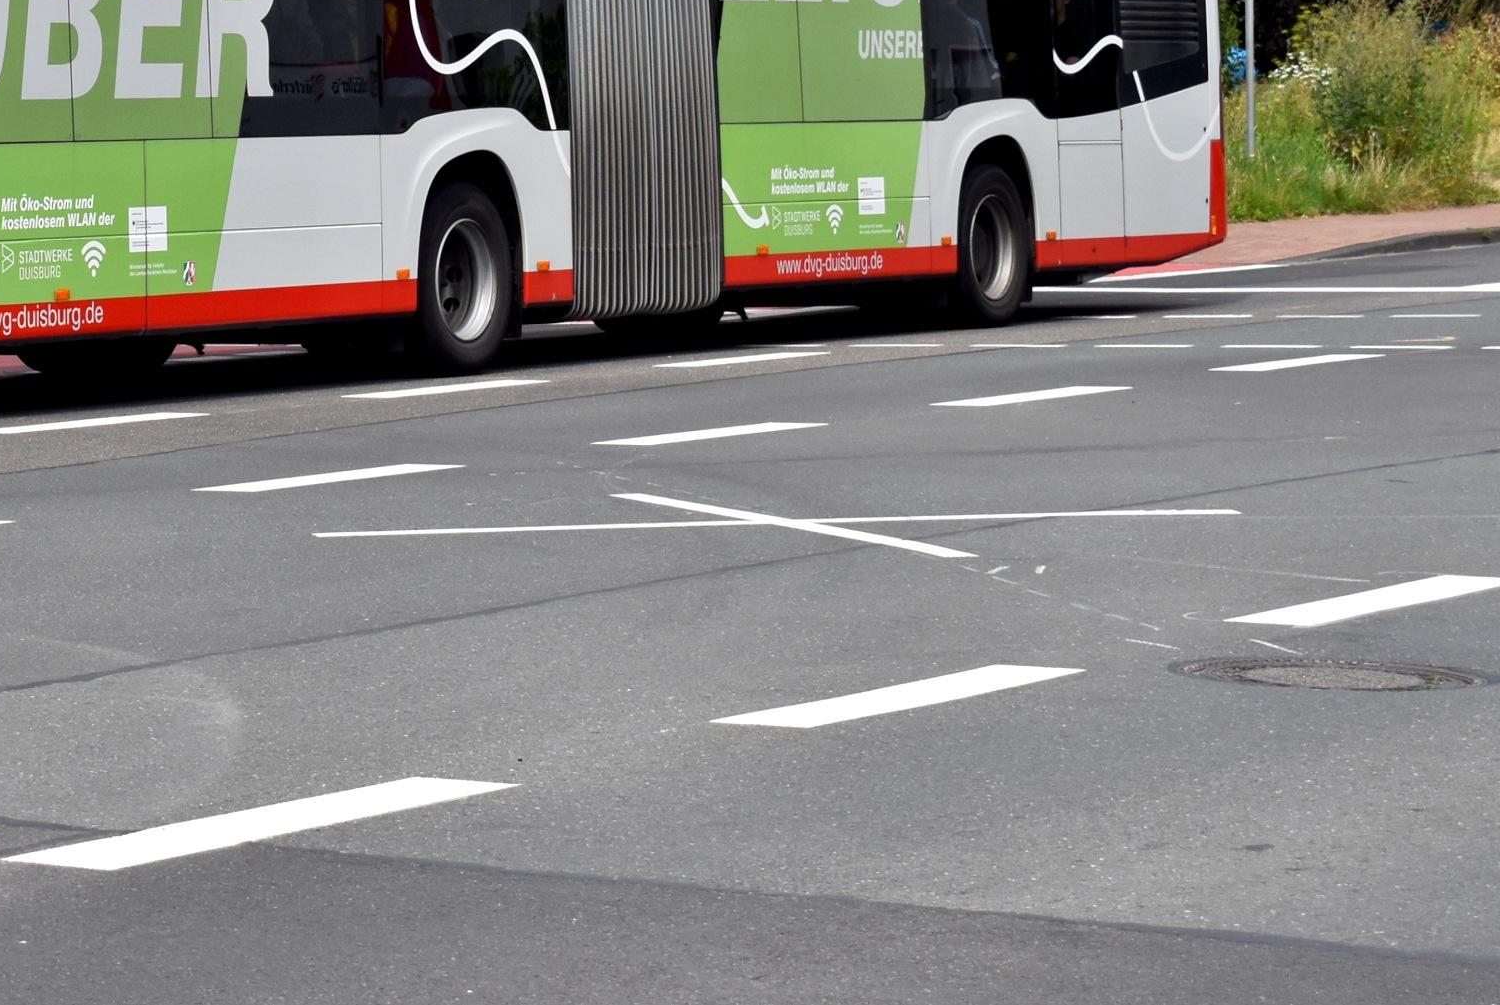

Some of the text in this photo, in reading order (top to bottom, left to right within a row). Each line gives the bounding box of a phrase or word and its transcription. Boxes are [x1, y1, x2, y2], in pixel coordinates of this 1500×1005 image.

[771, 164, 835, 180] Mit Öko-Strom und
[771, 182, 815, 195] kostenlosem
[816, 181, 836, 192] WLAN
[836, 180, 849, 192] der
[1, 194, 95, 213] Mit Öko-Strom und
[1, 212, 116, 231] kostenlosem WLAN der
[783, 209, 821, 223] STADTWERKE
[783, 223, 813, 236] DUISBURG
[18, 248, 73, 265] STADTWERKE
[776, 252, 883, 277] www.dvg-duisburg.de
[18, 264, 62, 281] DUISBURG
